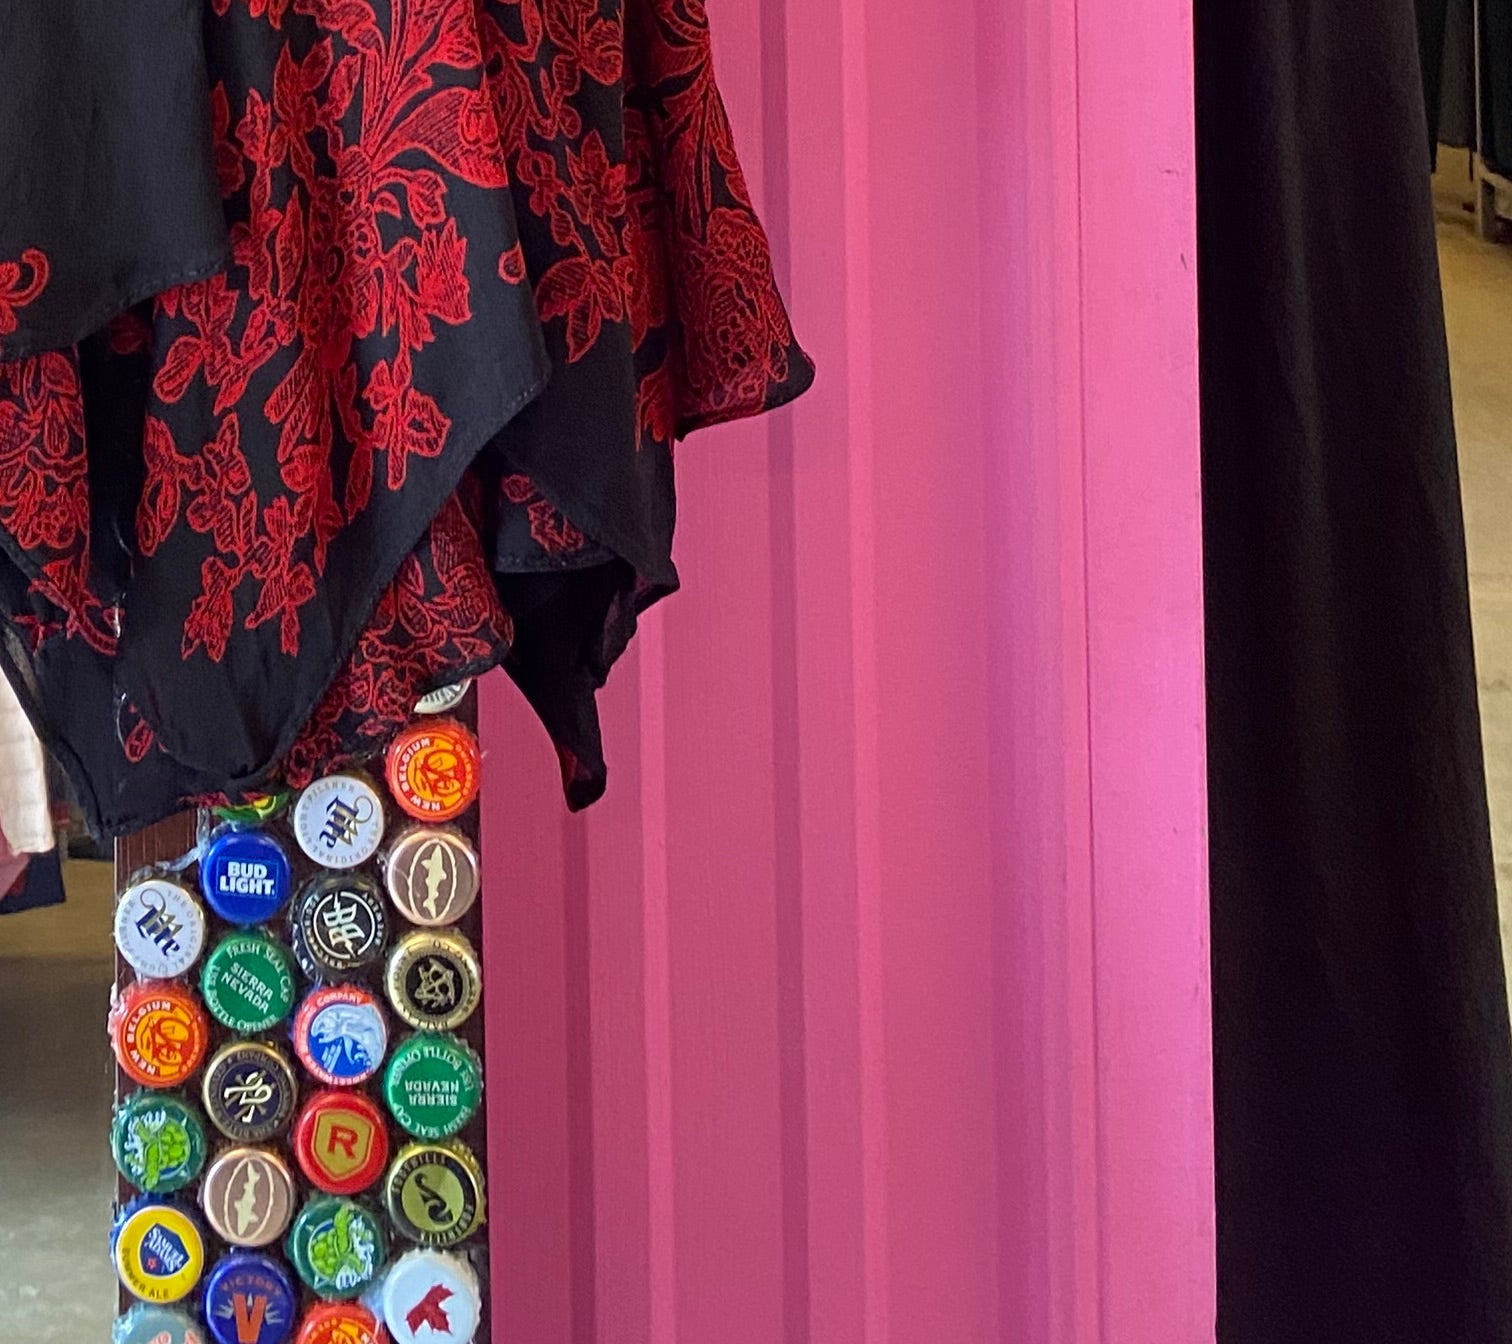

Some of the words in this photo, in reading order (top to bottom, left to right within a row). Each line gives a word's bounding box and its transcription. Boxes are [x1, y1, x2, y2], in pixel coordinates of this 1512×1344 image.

[398, 737, 431, 791] BELGIUM
[410, 794, 441, 811] NEW
[227, 861, 268, 878] BUD
[220, 876, 275, 895] LIGHT
[226, 942, 260, 959] FRESH
[264, 947, 284, 974] SEAL
[221, 974, 269, 1013] NEVADA
[231, 963, 274, 1000] SIERRA
[207, 989, 235, 1026] BOTTLE
[237, 1015, 278, 1032] OPENER
[317, 994, 362, 1004] COMPANY
[126, 1001, 171, 1044] BELGIUM
[129, 1049, 156, 1076] NEW
[424, 1046, 462, 1071] BOTTLE
[404, 1079, 460, 1092] NEVADA
[408, 1093, 457, 1107] SIERRA
[327, 1125, 359, 1159] R
[416, 1124, 439, 1137] SEAL
[122, 1248, 146, 1292] SUMMER
[148, 1286, 169, 1298] ALE
[221, 1274, 282, 1297] VICTORY
